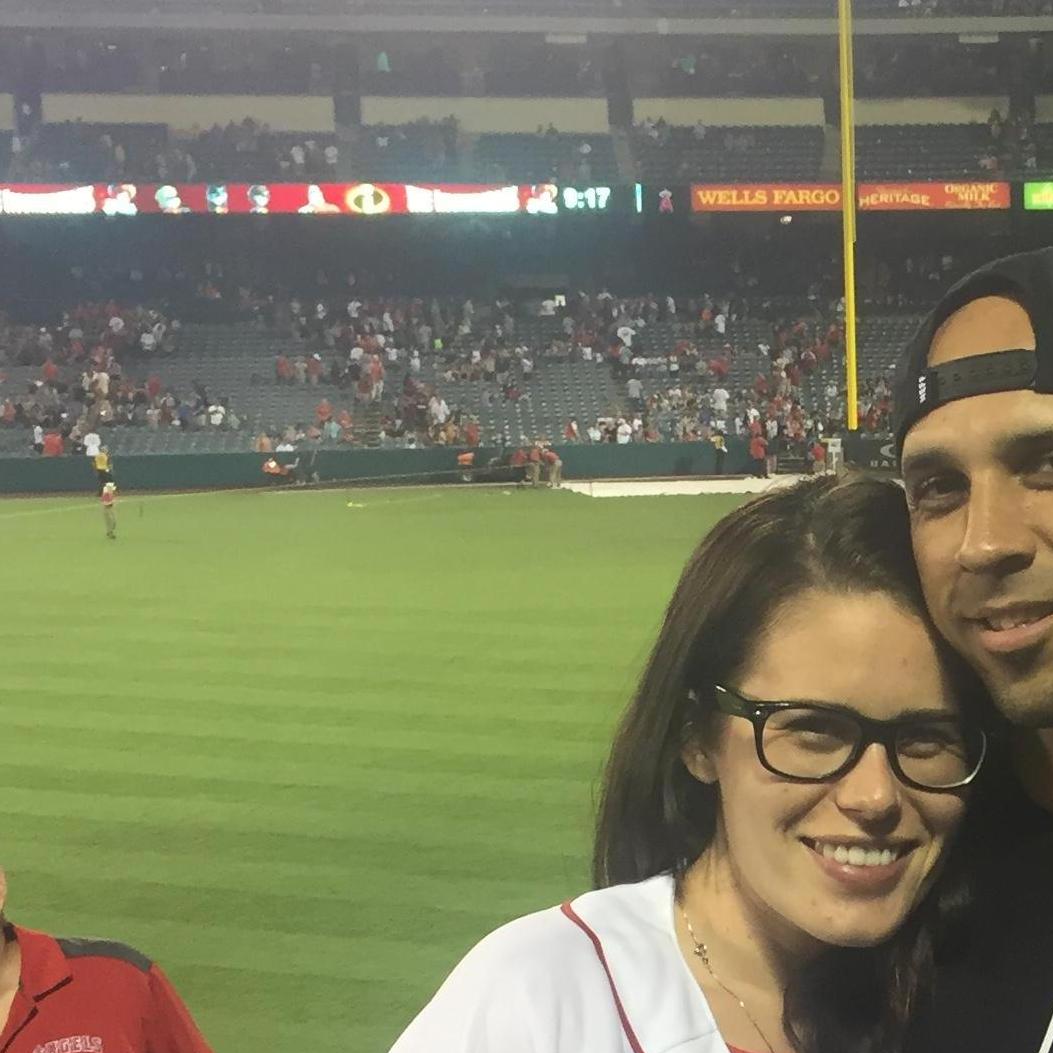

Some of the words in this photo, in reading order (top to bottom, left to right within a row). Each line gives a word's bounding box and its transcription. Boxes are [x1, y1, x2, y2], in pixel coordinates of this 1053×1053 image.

[697, 189, 768, 206] WELLS
[773, 189, 841, 206] FARGO
[858, 192, 932, 208] HERITAGE
